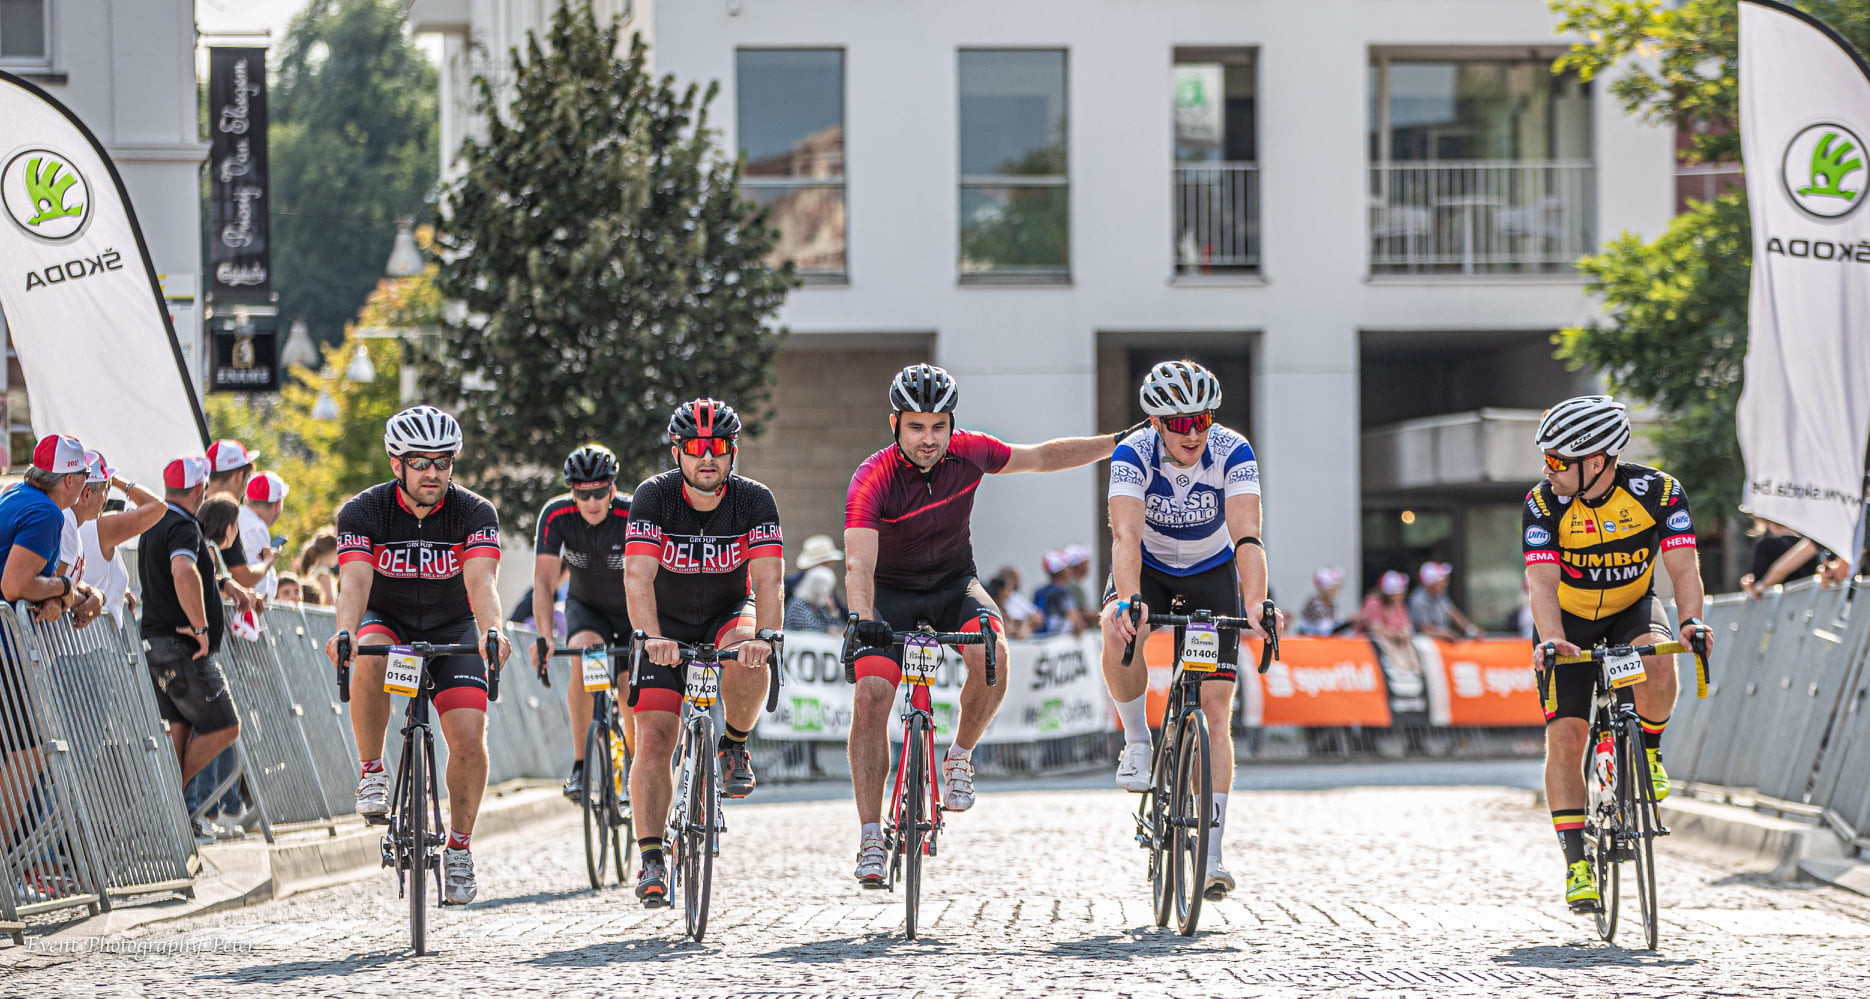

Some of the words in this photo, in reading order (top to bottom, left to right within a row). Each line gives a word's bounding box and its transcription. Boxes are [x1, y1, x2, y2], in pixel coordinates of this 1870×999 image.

[1570, 433, 1592, 449] LAZER
[1112, 465, 1143, 480] ASSA
[1230, 465, 1258, 479] FASS
[1660, 476, 1672, 506] JUMBO
[1527, 498, 1543, 519] VISMA
[1532, 488, 1551, 517] JUMBO
[1145, 508, 1217, 523] BORTOLO
[467, 529, 499, 544] DELR
[625, 521, 663, 541] DELRUE
[749, 525, 782, 541] DELRU
[337, 534, 370, 550] ELRUE
[378, 547, 460, 574] DELRUE
[662, 540, 742, 569] DELRUE
[1525, 552, 1554, 563] HEMA
[1561, 547, 1649, 567] JUMBO
[1588, 561, 1649, 582] VISMA
[1186, 649, 1217, 659] 01406
[905, 663, 936, 673] 01437
[1609, 660, 1641, 675] 01427
[387, 671, 419, 684] 01641
